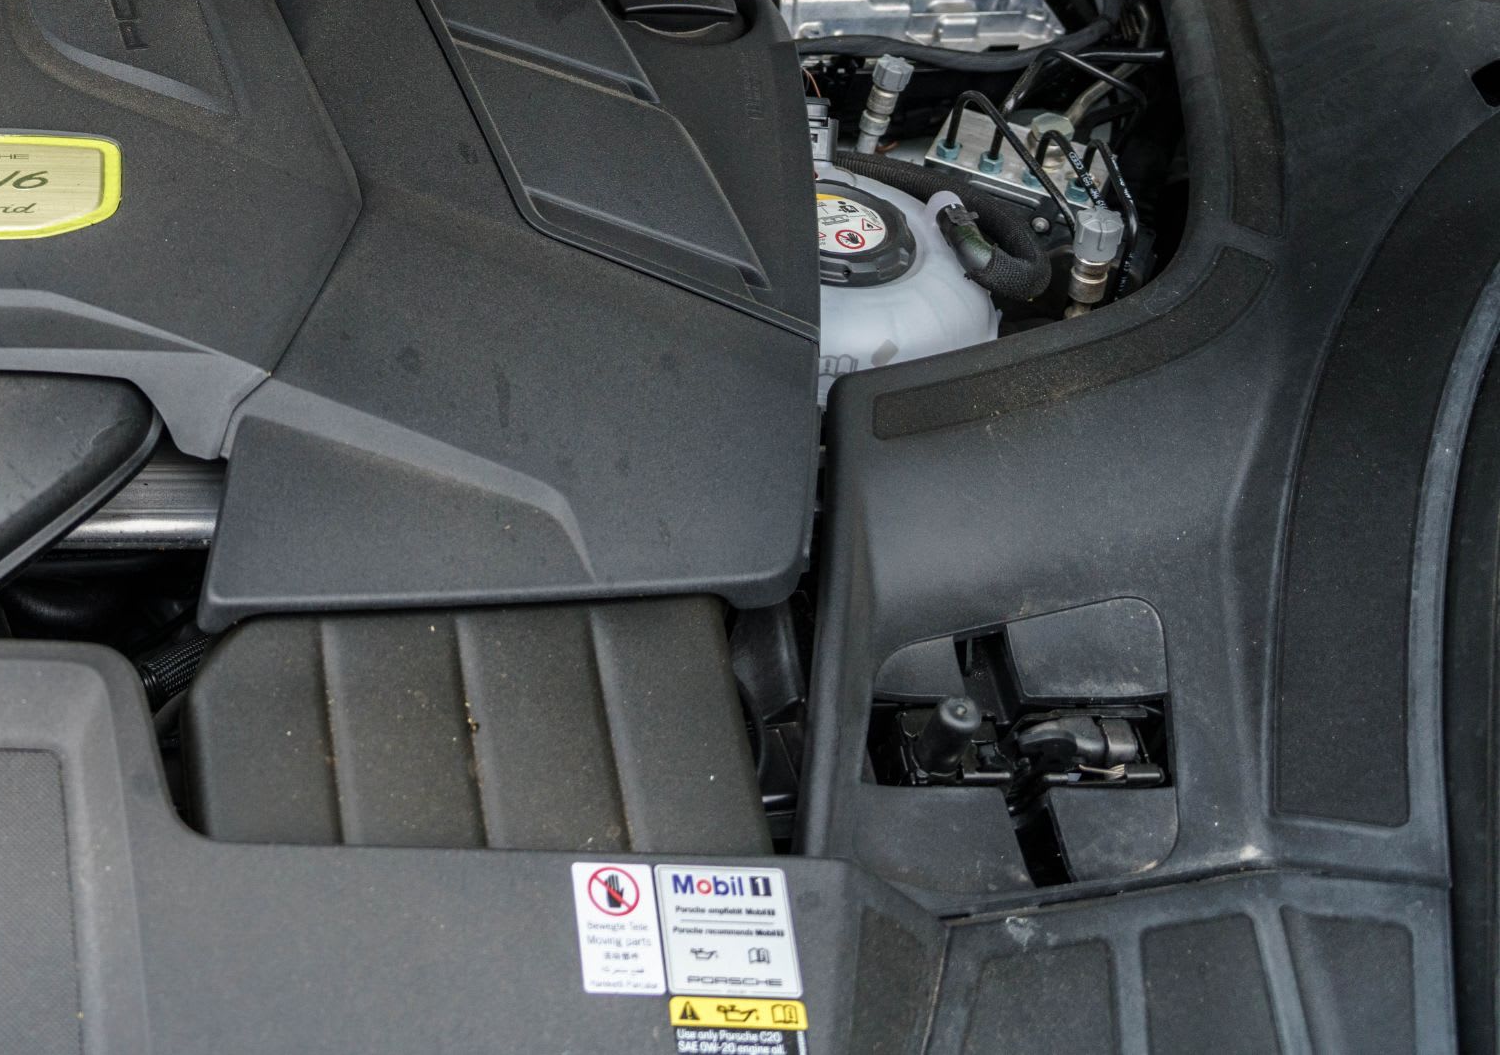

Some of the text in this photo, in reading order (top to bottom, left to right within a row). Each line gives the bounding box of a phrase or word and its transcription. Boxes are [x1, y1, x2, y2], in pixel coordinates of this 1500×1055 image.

[672, 874, 745, 896] Mobil
[675, 906, 706, 914] Porsche
[673, 926, 703, 934] Porsche
[587, 935, 652, 947] Moving parts
[687, 976, 783, 986] PORSCHE
[676, 1028, 783, 1043] Use only Porsche C20
[677, 1041, 787, 1055] SAE 0W-20 engine oil.
